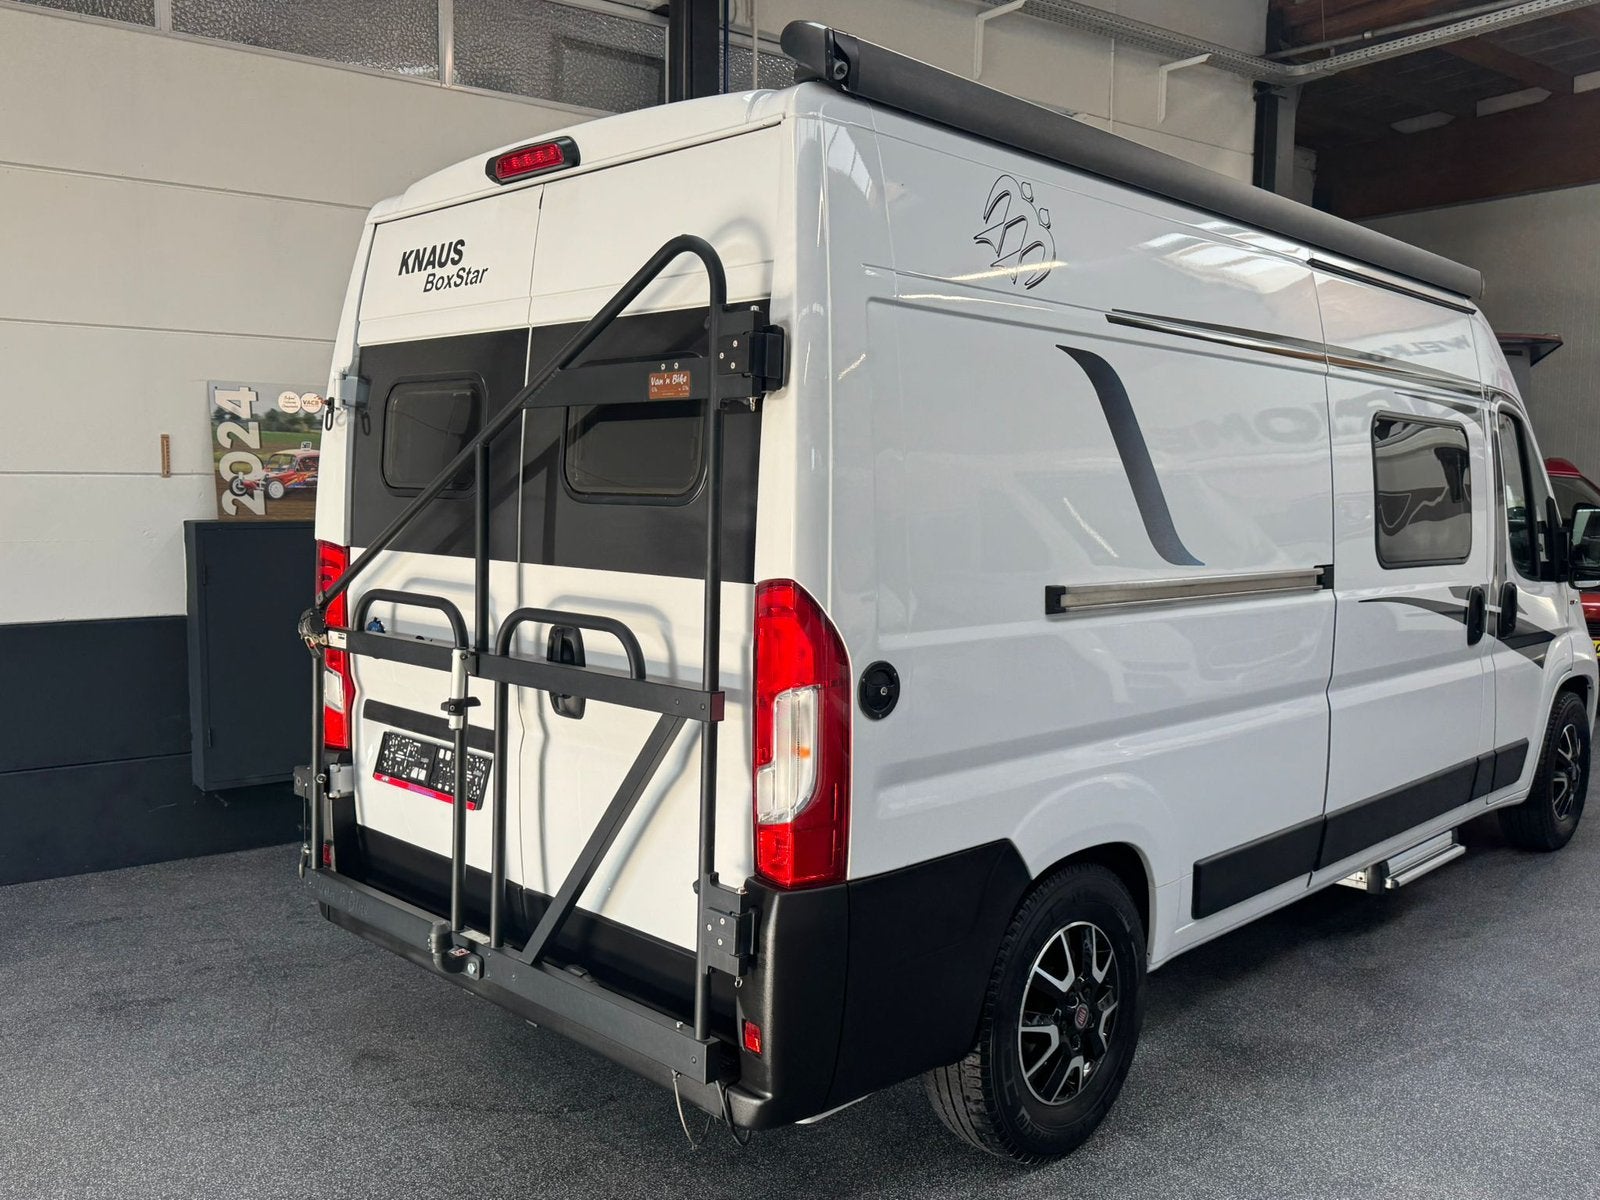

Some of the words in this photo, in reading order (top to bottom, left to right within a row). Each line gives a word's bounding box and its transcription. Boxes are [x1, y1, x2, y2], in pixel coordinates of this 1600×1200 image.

[398, 239, 466, 276] KNAUS
[423, 267, 489, 293] BoxStar
[214, 386, 267, 516] 2024
